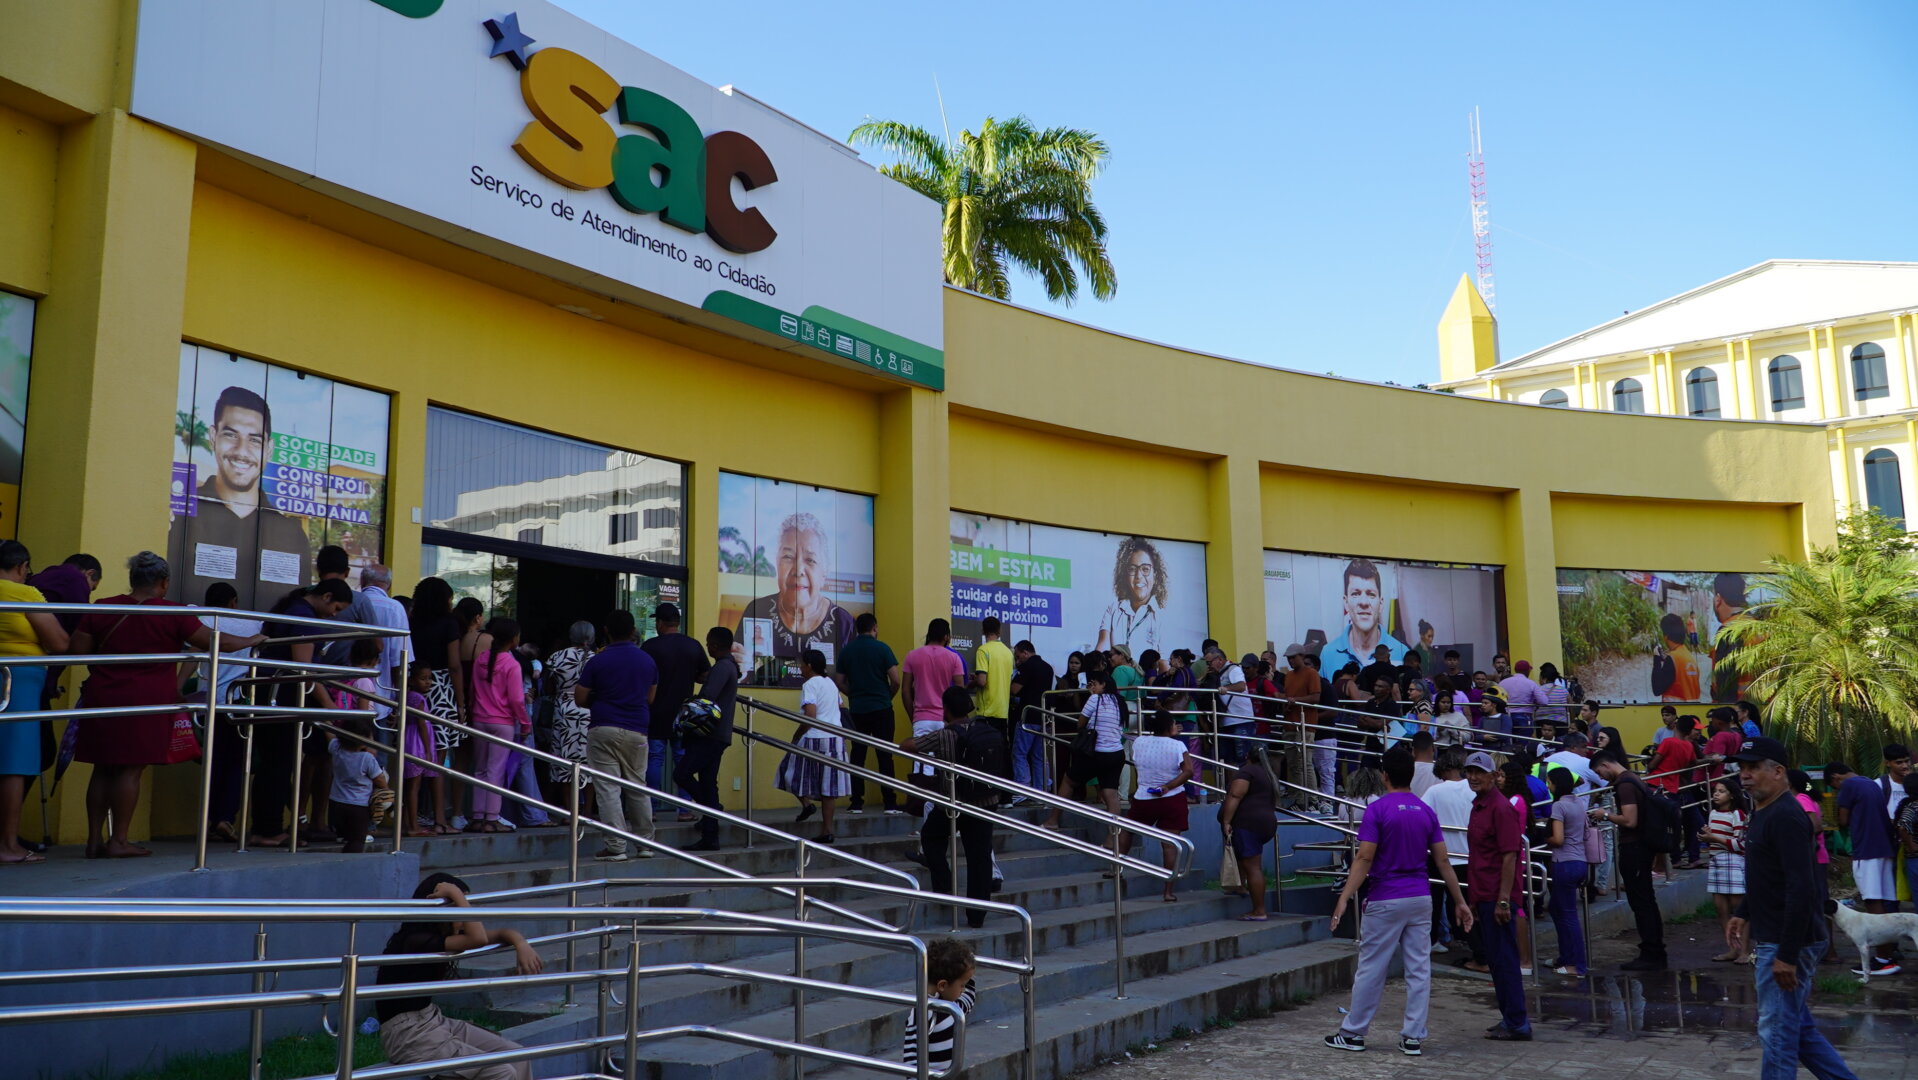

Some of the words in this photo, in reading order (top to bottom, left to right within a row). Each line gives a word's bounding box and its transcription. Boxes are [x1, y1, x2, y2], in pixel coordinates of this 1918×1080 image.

[512, 47, 778, 254] sac
[470, 165, 543, 207] Serviço
[551, 199, 575, 221] de
[581, 210, 688, 263] Atendimento
[694, 253, 713, 272] ao
[718, 261, 776, 296] Cidadão
[279, 435, 374, 466] SOCIEDADE
[307, 456, 328, 471] SE
[276, 481, 314, 499] COM
[277, 466, 362, 493] CONSTRÓI
[275, 497, 369, 524] CIDADANIA
[950, 550, 983, 572] BEM
[999, 557, 1056, 581] ESTAR
[659, 585, 680, 593] VAGAS
[957, 588, 992, 602] cuidar
[994, 591, 1008, 604] de
[1011, 593, 1021, 606] si
[1023, 597, 1049, 608] para
[984, 606, 999, 618] do
[1002, 607, 1048, 624] próximo
